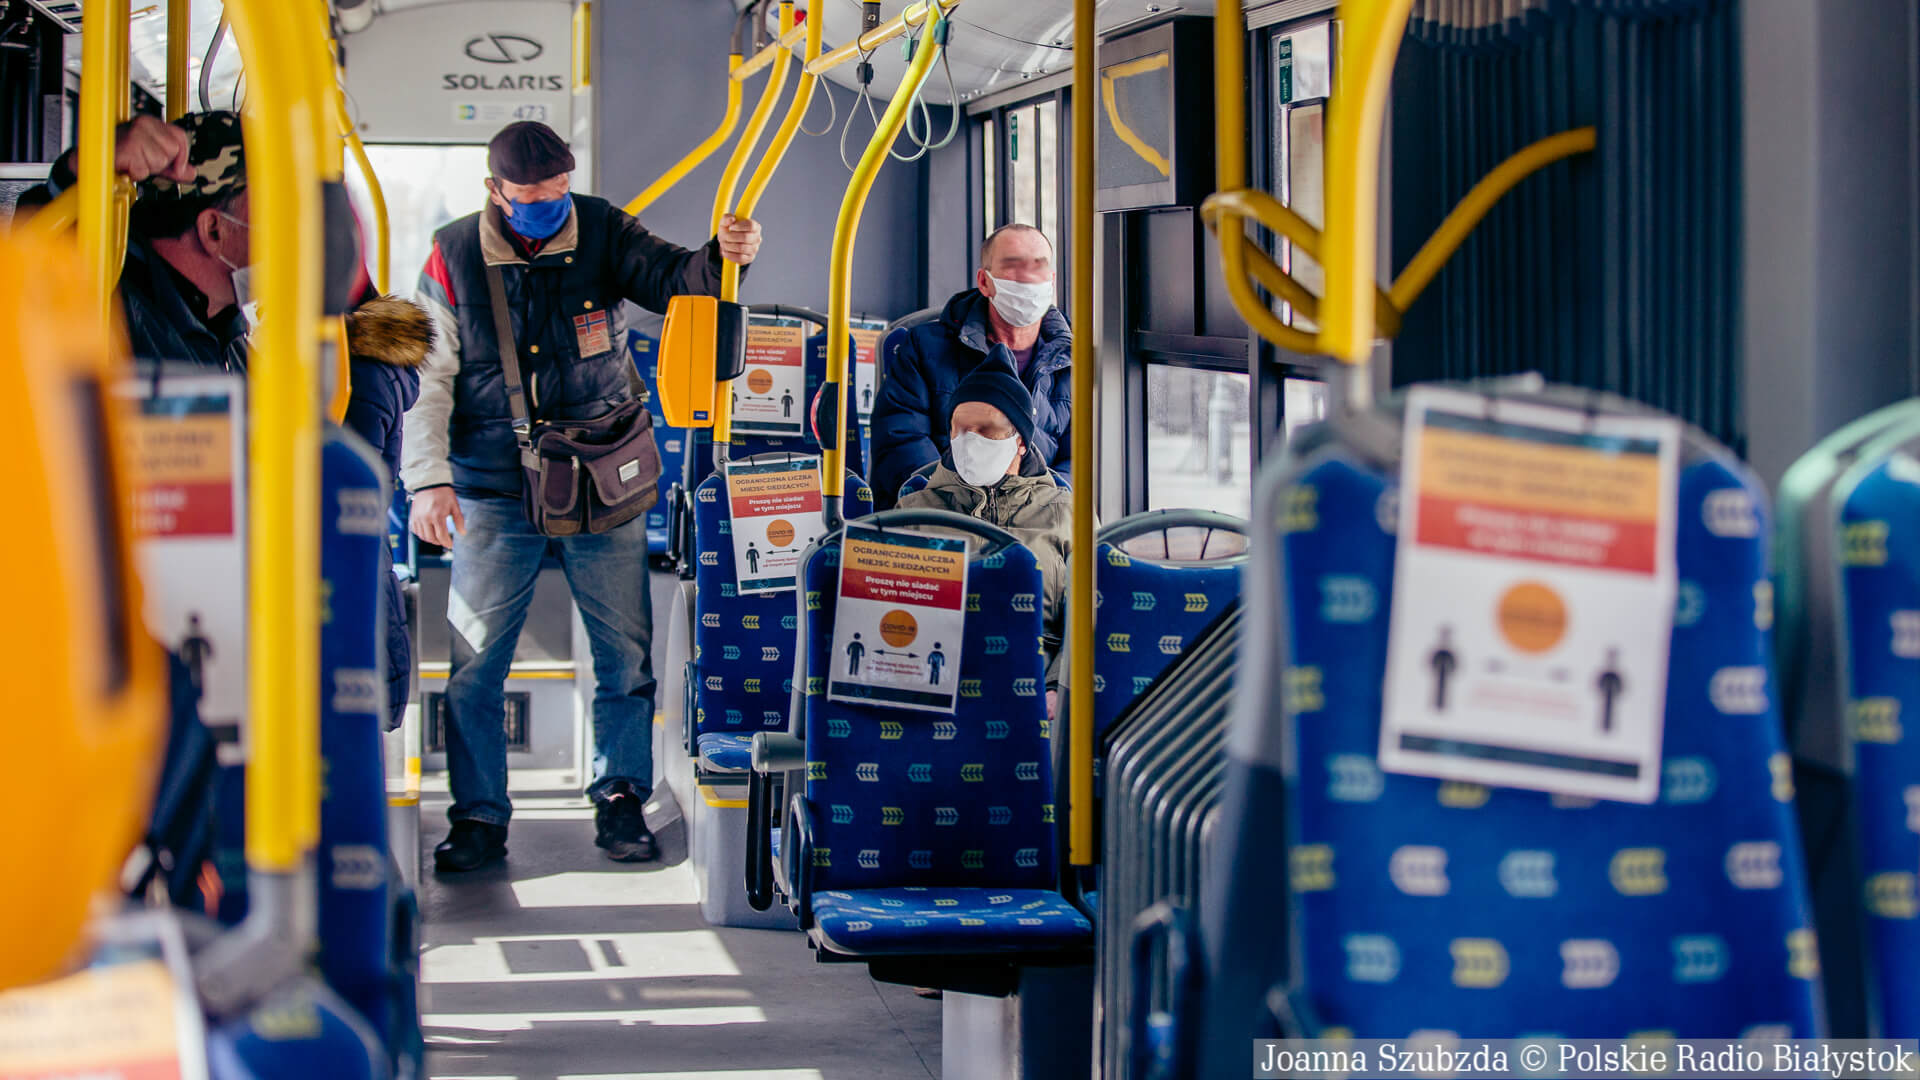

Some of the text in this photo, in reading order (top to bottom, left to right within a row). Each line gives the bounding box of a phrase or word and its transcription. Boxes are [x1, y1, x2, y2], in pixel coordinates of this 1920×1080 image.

[442, 74, 563, 91] SOLARIS
[513, 104, 547, 121] 473
[735, 474, 813, 485] OGRANICZONA LICZBA
[761, 505, 775, 513] tym
[852, 546, 956, 564] OGRANICZONA LICZBA
[857, 557, 950, 574] MIEJSC SIEDZĄCYCH
[865, 575, 940, 591] Proszę nie siadać
[879, 587, 898, 598] tym
[899, 588, 934, 601] miejscu
